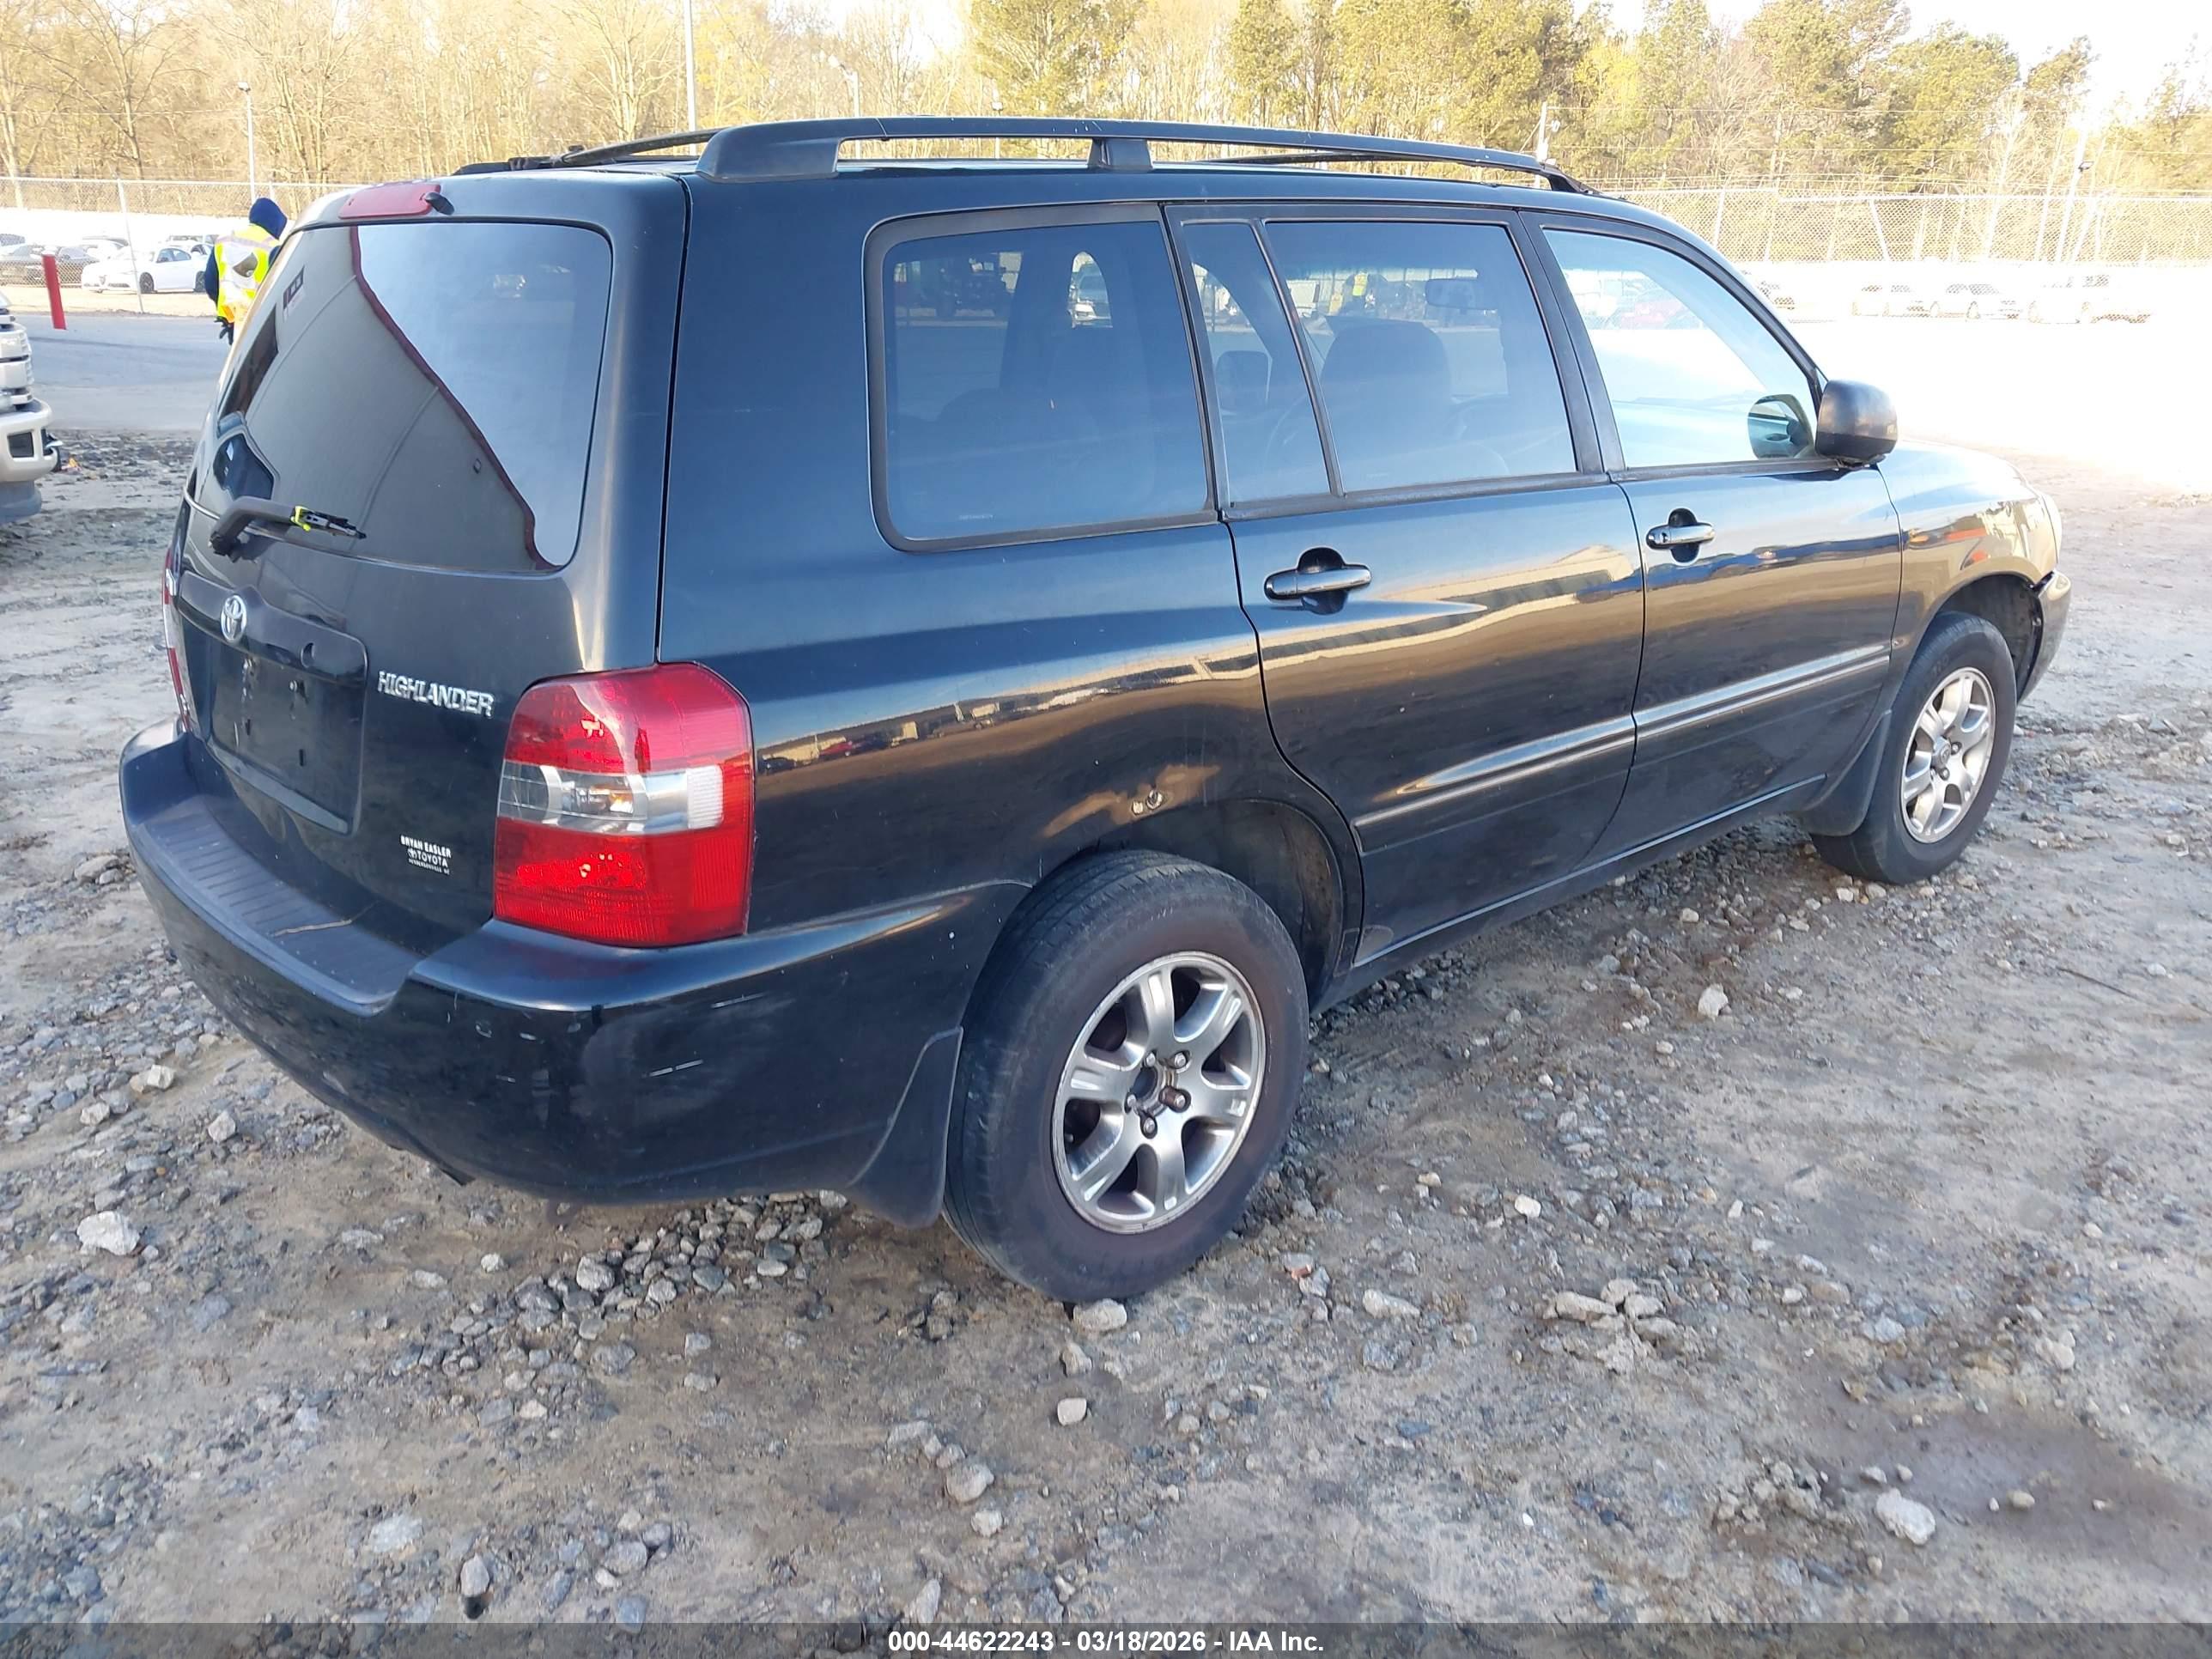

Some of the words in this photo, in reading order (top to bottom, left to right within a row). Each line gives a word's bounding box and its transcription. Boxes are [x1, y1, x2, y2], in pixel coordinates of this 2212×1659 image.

[378, 670, 495, 718] HIGHLANDER
[416, 849, 448, 868] TOYOTA
[424, 842, 452, 859] EASLER
